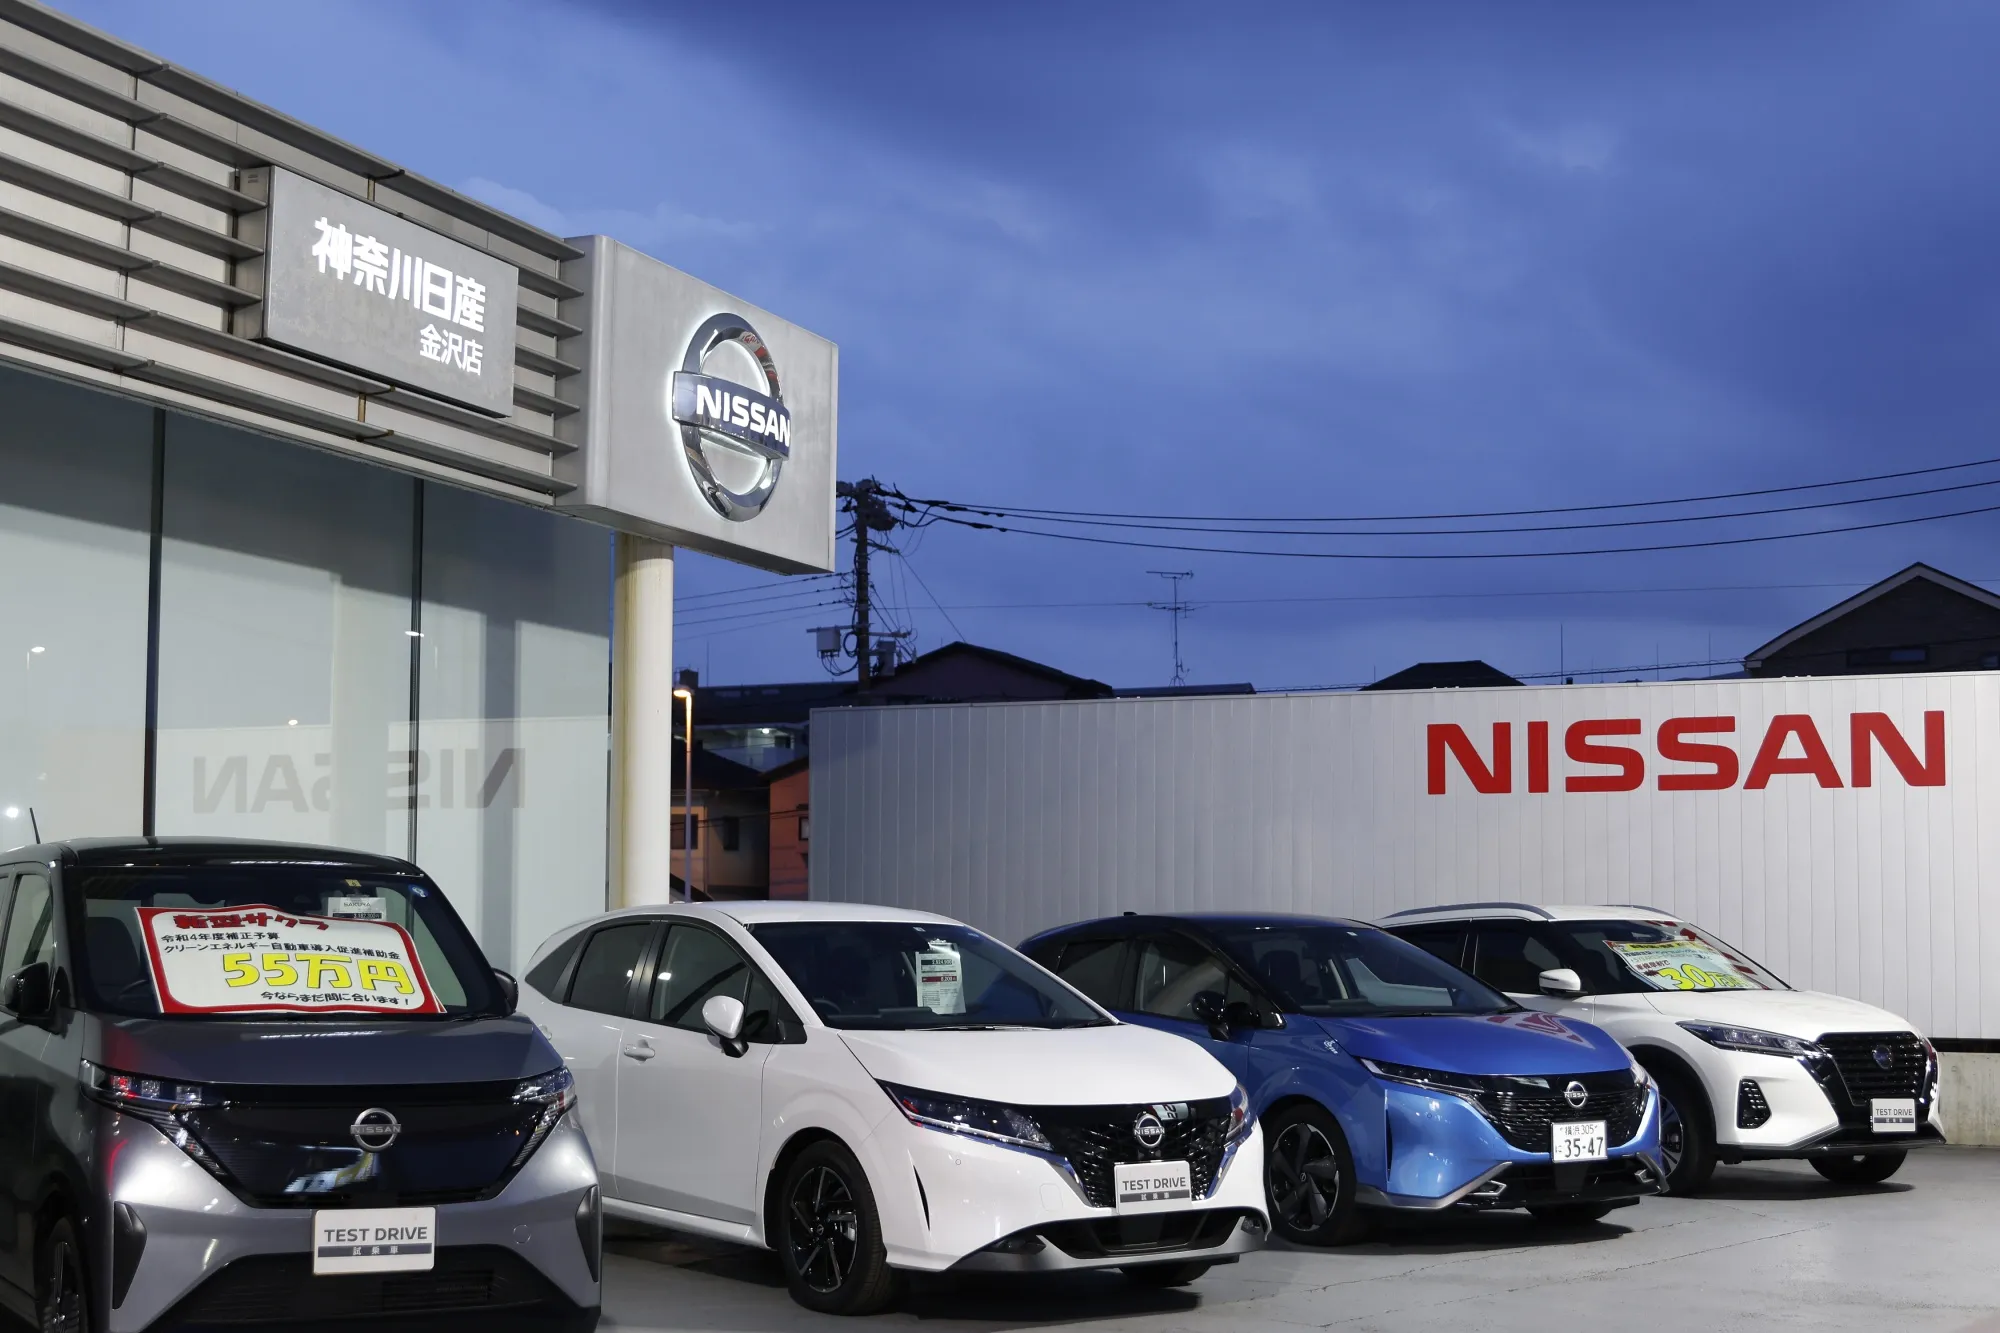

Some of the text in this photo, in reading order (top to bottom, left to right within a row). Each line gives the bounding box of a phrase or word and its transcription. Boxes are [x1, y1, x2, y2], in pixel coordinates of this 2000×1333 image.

[312, 217, 486, 333] 神奈川日産
[419, 324, 483, 376] 金沢店
[696, 384, 790, 447] NISSAN
[1427, 711, 1946, 795] NISSAN
[161, 932, 280, 942] 令和4年度補正予算
[164, 942, 401, 960] クリーンエネルギー自動車導入促進補助金
[223, 953, 415, 994] 55万円
[352, 1125, 401, 1134] NISSAN
[1122, 1177, 1186, 1190] TEST DRIVE
[324, 1227, 427, 1242] TEST DRIVE
[353, 1246, 398, 1256] 試乗車
